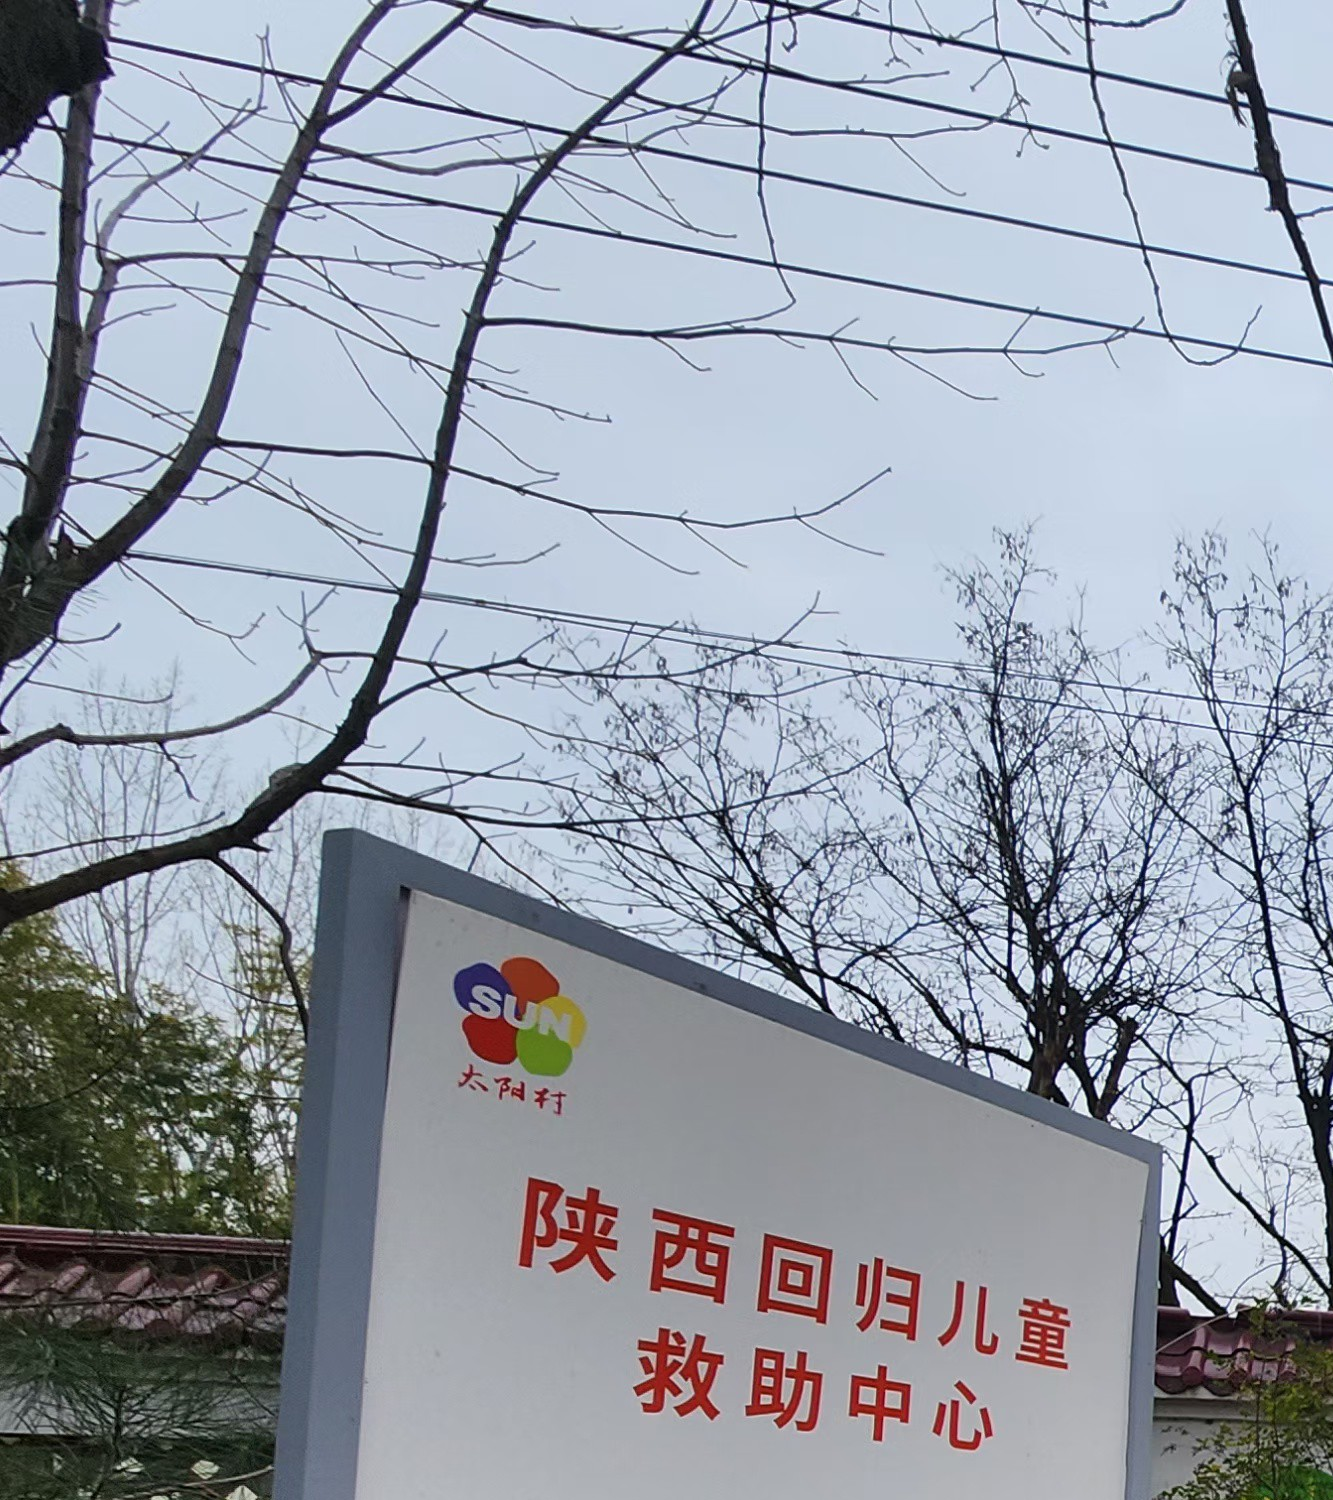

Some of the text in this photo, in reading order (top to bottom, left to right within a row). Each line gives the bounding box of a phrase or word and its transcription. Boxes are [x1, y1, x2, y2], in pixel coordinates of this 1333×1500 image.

[468, 984, 573, 1045] SUN
[458, 1063, 567, 1116] 太阳村
[518, 1177, 1072, 1371] 陕西回归儿童
[634, 1328, 994, 1452] 救助中心
